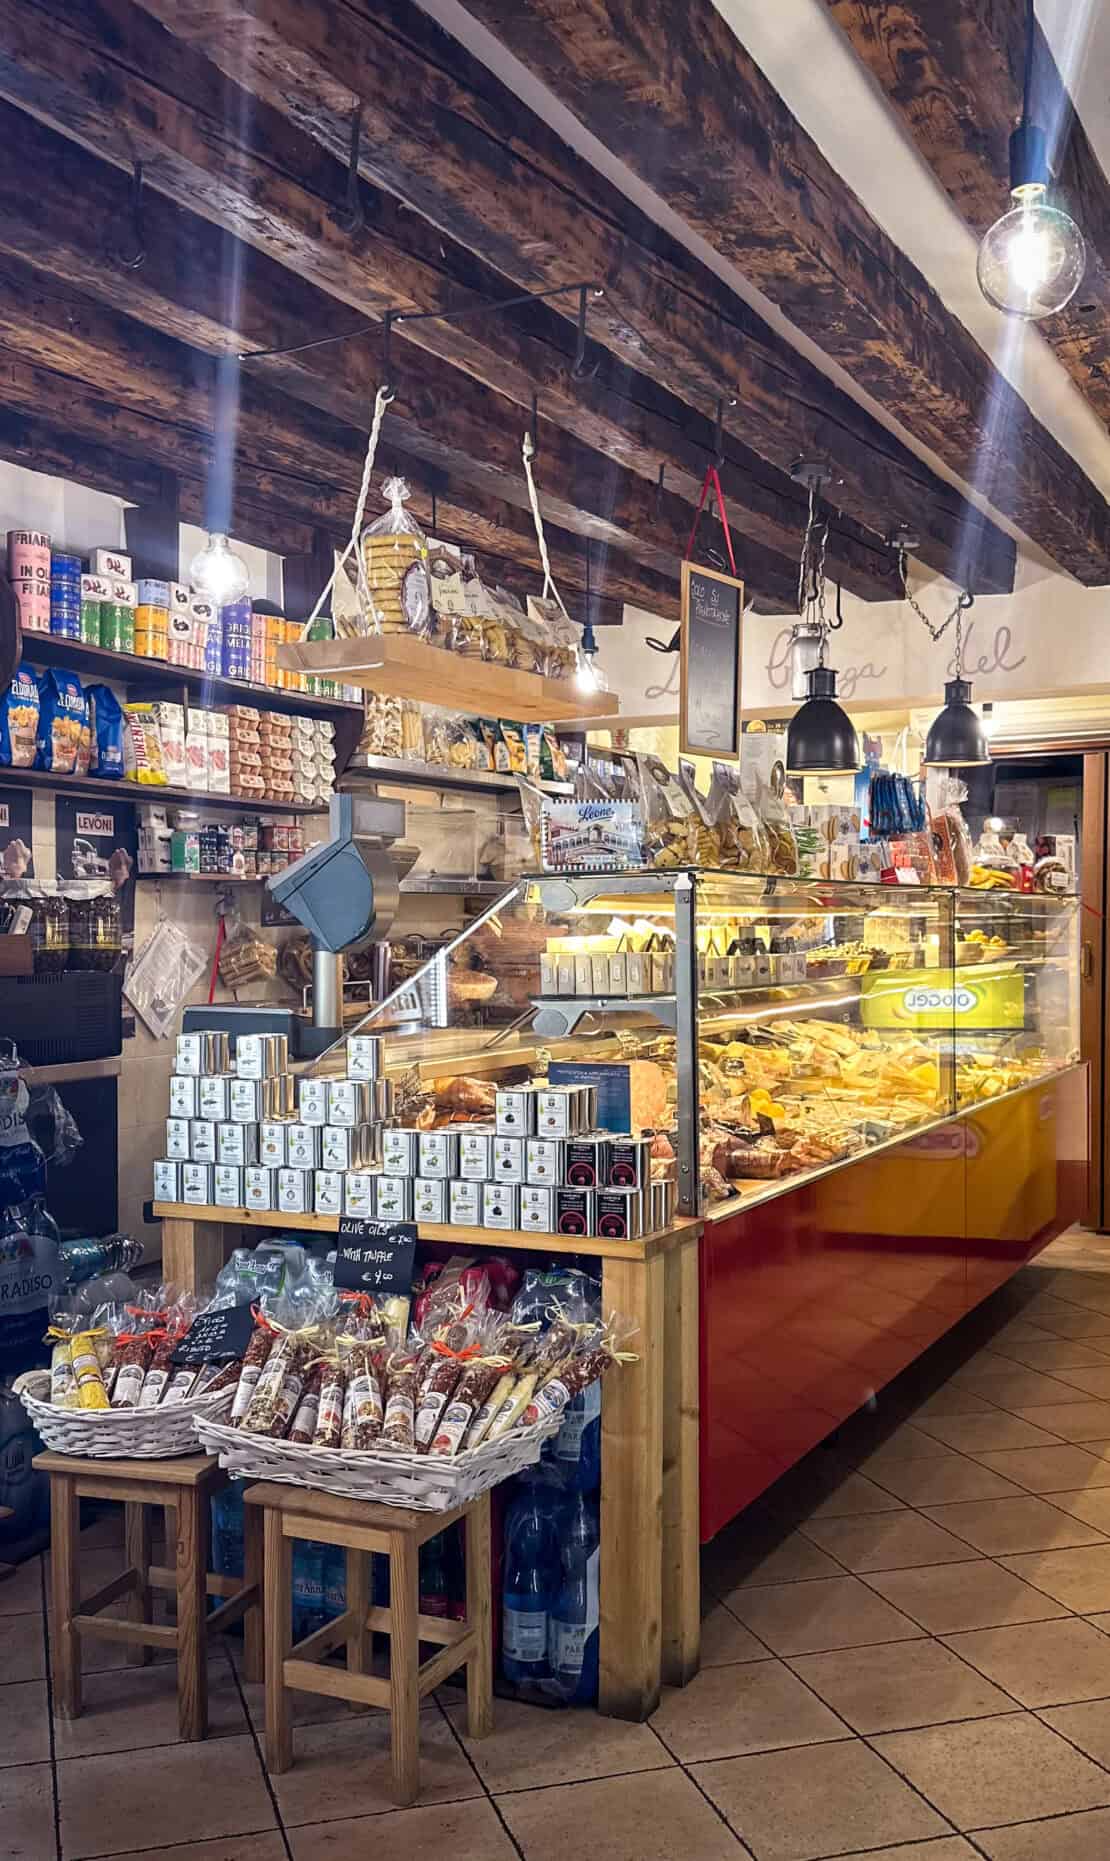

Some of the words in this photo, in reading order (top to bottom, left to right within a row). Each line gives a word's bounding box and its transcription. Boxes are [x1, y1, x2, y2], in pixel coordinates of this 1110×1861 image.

[946, 621, 1027, 676] del
[579, 804, 615, 821] Leone
[78, 816, 113, 832] LEVONI
[340, 1221, 365, 1235] OLIVE
